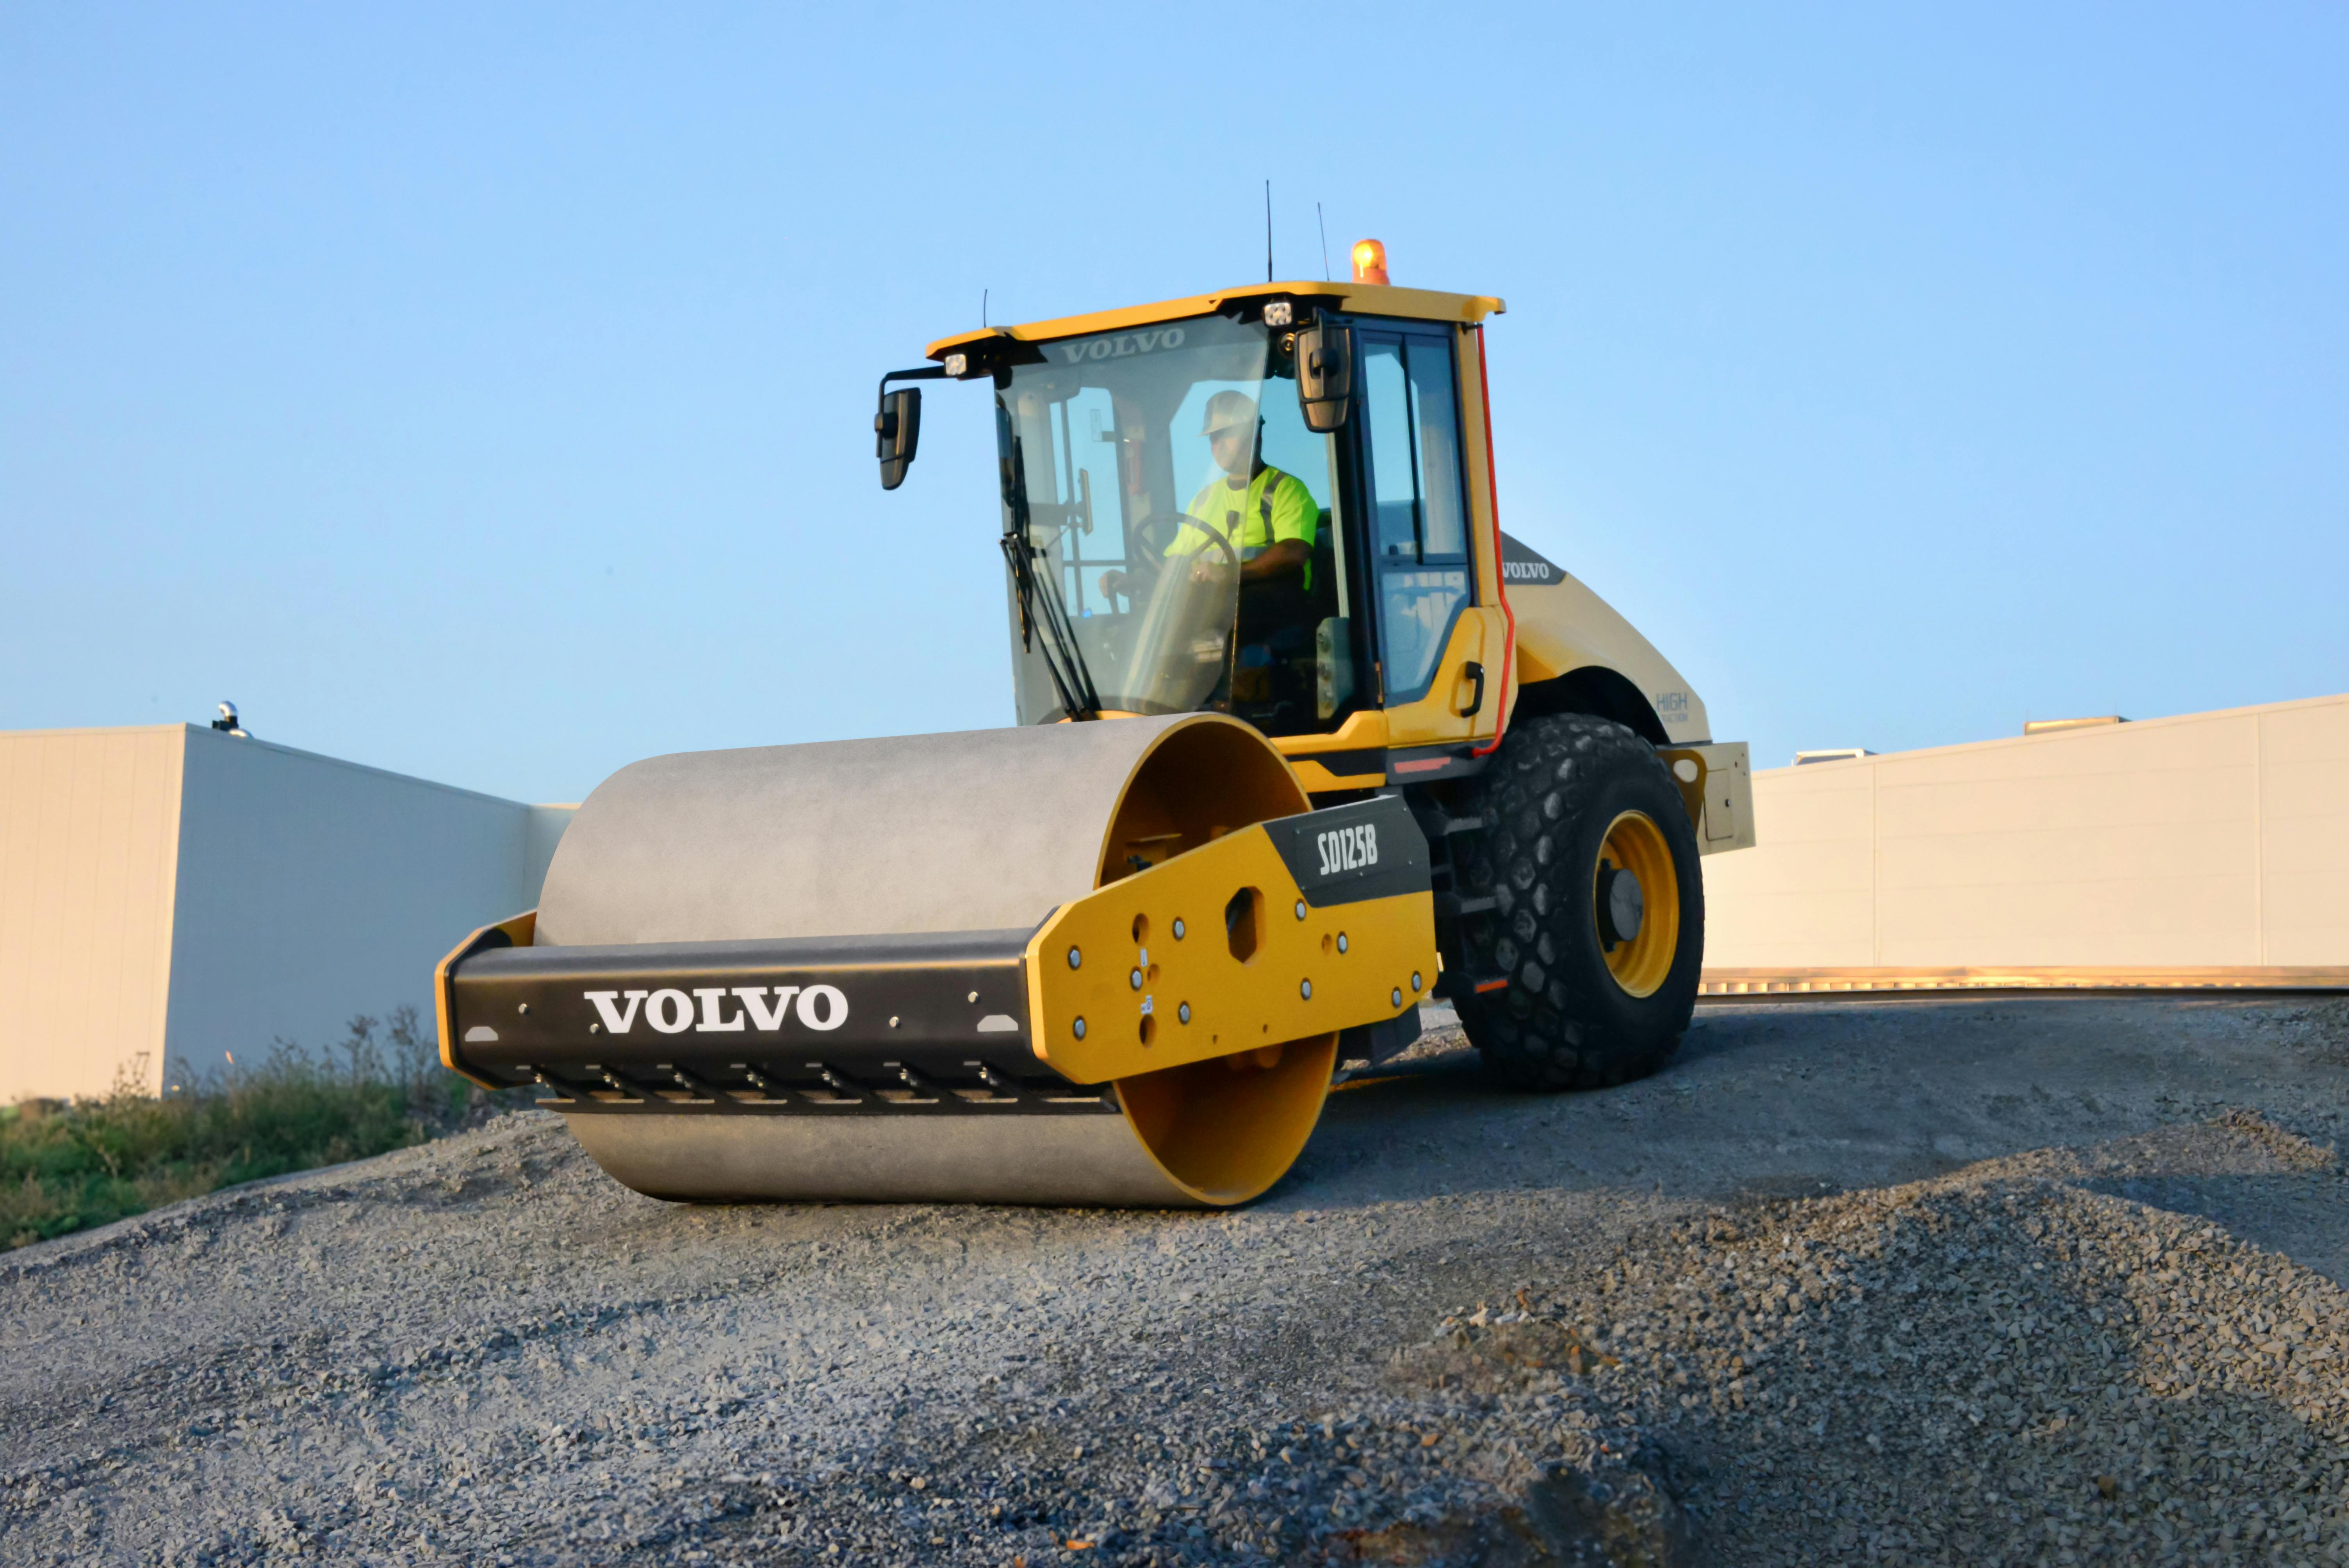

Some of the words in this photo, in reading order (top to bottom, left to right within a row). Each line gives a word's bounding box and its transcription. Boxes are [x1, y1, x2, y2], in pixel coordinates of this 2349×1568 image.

[1061, 328, 1185, 364] VOLVO
[1656, 692, 1688, 711] HIGH
[1317, 824, 1378, 875] SD125B
[584, 984, 848, 1033] VOLVO
